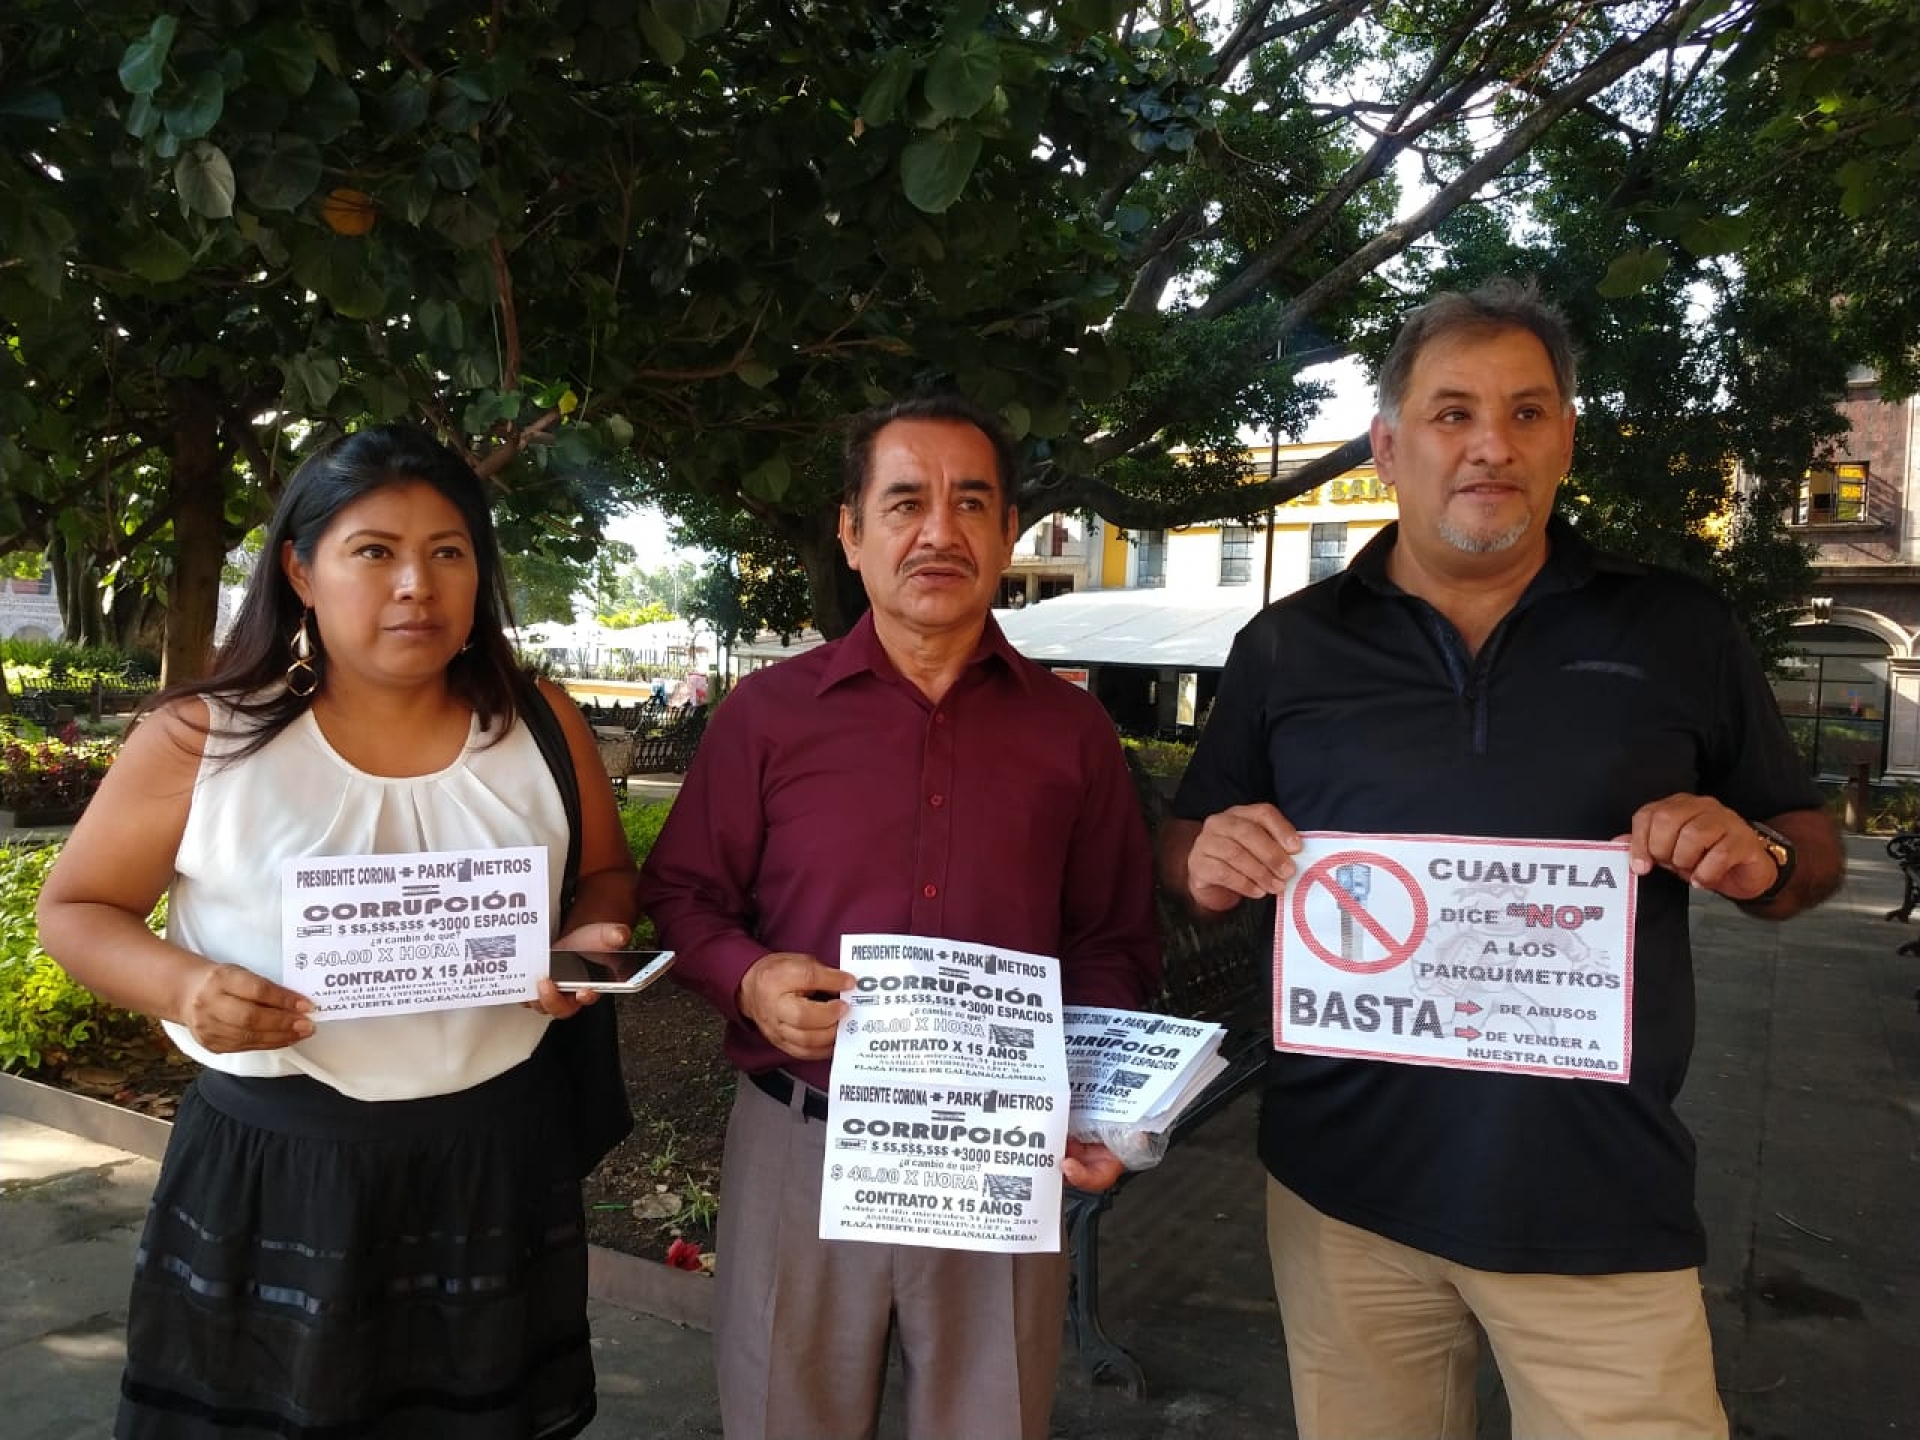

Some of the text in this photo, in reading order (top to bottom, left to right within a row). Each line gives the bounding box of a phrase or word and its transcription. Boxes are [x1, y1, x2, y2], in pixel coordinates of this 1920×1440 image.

[297, 868, 355, 888] PRESIDENTE
[358, 867, 397, 883] CORONA
[418, 862, 456, 879] PARK
[474, 858, 531, 876] METROS
[1428, 858, 1617, 889] CUAUTLA
[474, 911, 538, 928] ESPACIOS
[1440, 908, 1498, 924] DICE
[377, 947, 394, 962] X
[399, 942, 460, 960] HORA
[1482, 939, 1557, 958] A LOS
[325, 960, 508, 987] CONTRATO X 15 AÑOS
[851, 945, 900, 960] PRESIDENTE
[902, 946, 935, 962] CORONA
[952, 950, 984, 968] PARK
[997, 958, 1046, 979] METROS
[1419, 962, 1621, 989] PARQUIMETROS
[998, 1006, 1053, 1024] ESPACIOS
[1289, 986, 1445, 1038] BASTA
[1500, 1004, 1597, 1021] DE ABUSOS
[914, 1017, 929, 1031] X
[933, 1018, 985, 1037] HORA
[1158, 1022, 1203, 1038] METROS
[869, 1038, 1028, 1061] CONTRATO X 15 AÑOS
[1486, 1031, 1601, 1051] DE VENDER A
[1467, 1047, 1619, 1071] NUESTRA CIUDAD
[840, 1084, 891, 1103] PRESIDENTE
[893, 1088, 927, 1106] CORONA
[947, 1091, 982, 1107] PARK
[998, 1093, 1054, 1112] METROS
[994, 1150, 1054, 1168] ESPACIOS
[903, 1169, 919, 1186] X
[923, 1171, 979, 1192] HORA
[855, 1189, 1023, 1217] CONTRATO X 15 AÑOS
